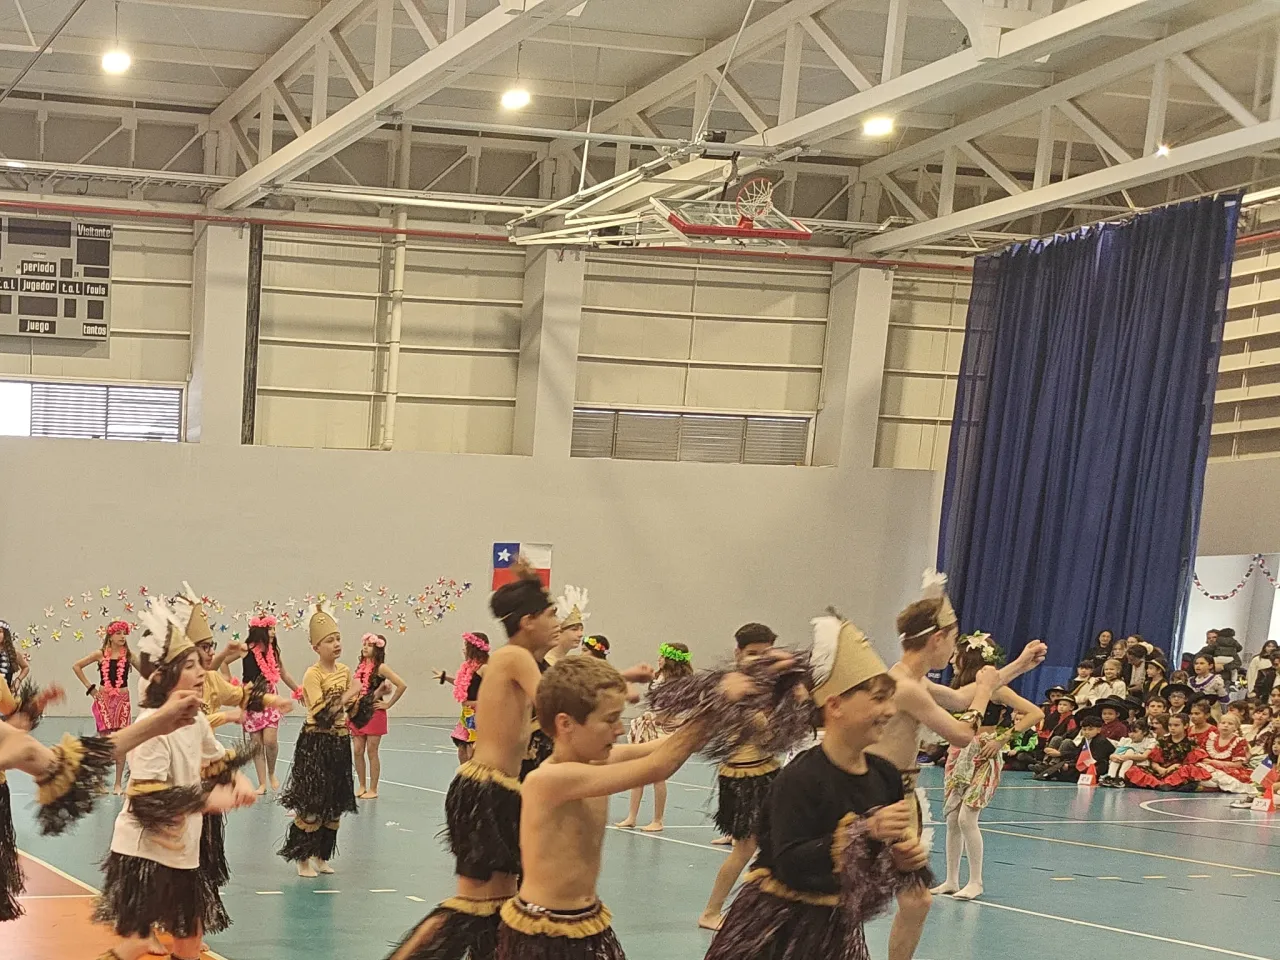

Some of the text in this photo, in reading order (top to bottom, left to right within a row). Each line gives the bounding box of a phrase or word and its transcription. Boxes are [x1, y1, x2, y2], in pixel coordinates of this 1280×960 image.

[77, 223, 111, 238] Visitante
[23, 261, 55, 274] periodo
[22, 279, 55, 292] jugador
[86, 284, 106, 295] fouls
[26, 320, 50, 333] juego
[83, 324, 107, 336] tantos
